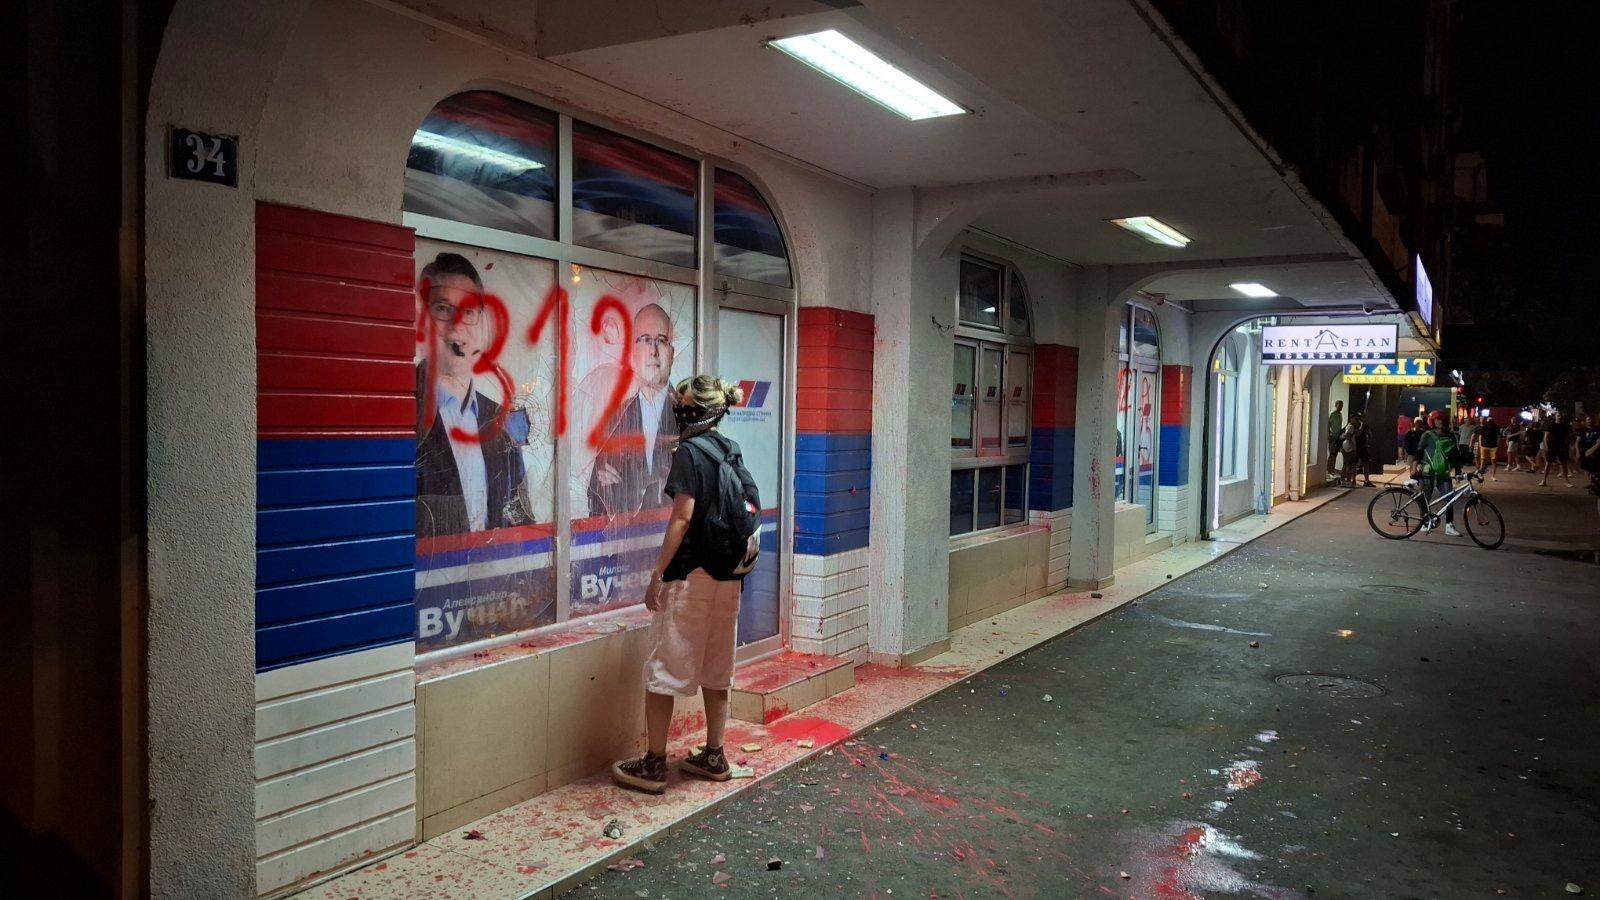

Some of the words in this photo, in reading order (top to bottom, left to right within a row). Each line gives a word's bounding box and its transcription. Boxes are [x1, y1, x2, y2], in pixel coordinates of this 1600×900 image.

[186, 133, 226, 177] 34
[416, 276, 646, 451] 1312
[1274, 352, 1381, 360] NEKRETNINE
[581, 569, 651, 601] Вучев
